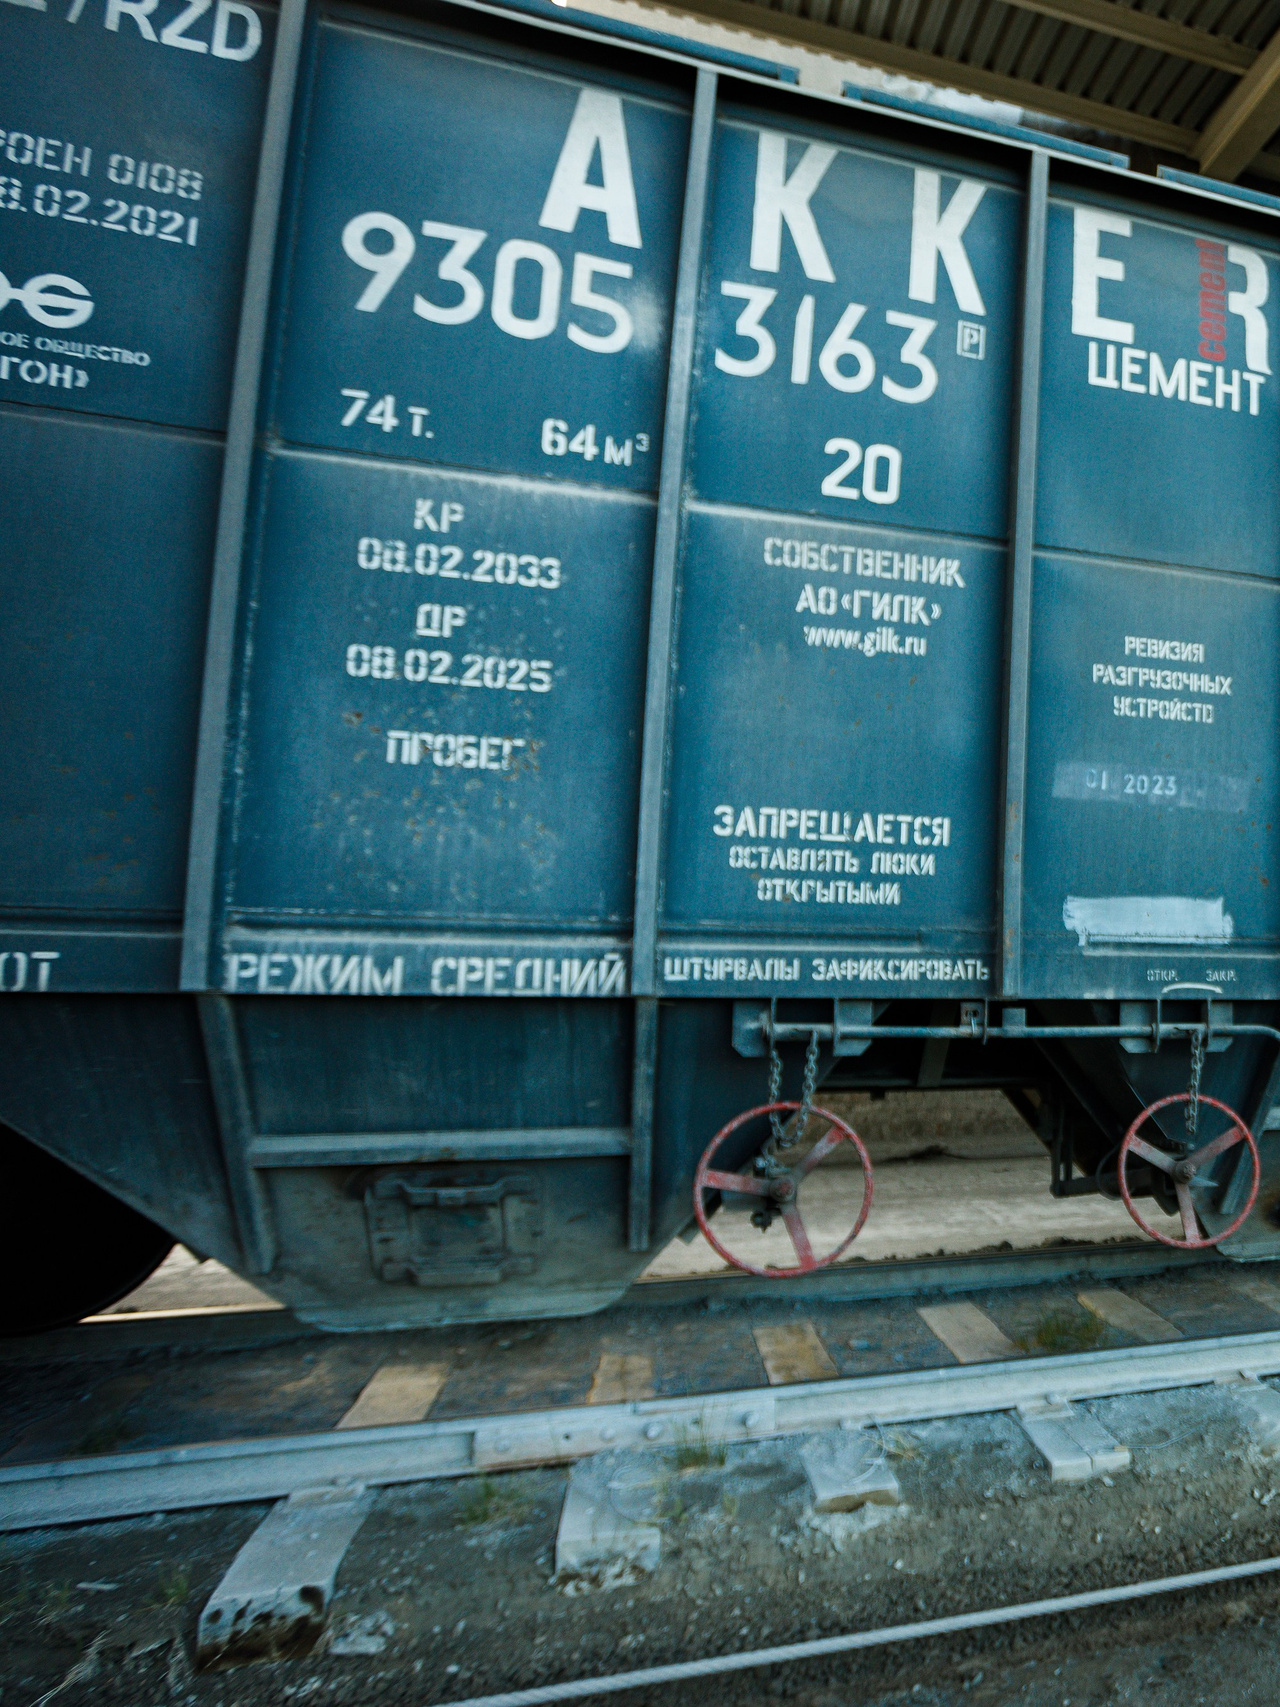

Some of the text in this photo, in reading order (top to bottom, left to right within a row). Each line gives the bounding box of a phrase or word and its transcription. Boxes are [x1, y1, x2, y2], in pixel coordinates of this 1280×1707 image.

[341, 211, 633, 354] 9305
[715, 280, 938, 404] 3163
[34, 336, 151, 367] ОБЩЕСТВО
[1088, 341, 1266, 416] ЦЕМЕНТ
[821, 437, 902, 505] 20
[413, 498, 464, 533] КР
[357, 537, 562, 589] 08.02.2033
[763, 536, 966, 588] СОБСТВЕННИК
[416, 603, 467, 638] ДР
[803, 625, 928, 657] www.gilk.ru
[1124, 635, 1205, 663] РЕВИЗИЯ
[1092, 663, 1233, 696] РАЗГРУЗОЧНЫХ
[386, 729, 526, 770] ПРОБЕГ
[1123, 773, 1178, 796] 2023
[713, 804, 951, 847] ЗАПРЕЩАЕТСЯ
[728, 844, 937, 876] ОСТАВЛЯТЬ ЛЮКИ
[757, 877, 901, 905] ОТКРЫТЫМИ
[222, 952, 627, 996] РЕЖИМ СРЕДНИЙ
[663, 956, 991, 982] ШТУРВАЛЫ ЗАФИКСИРОВАТЬ
